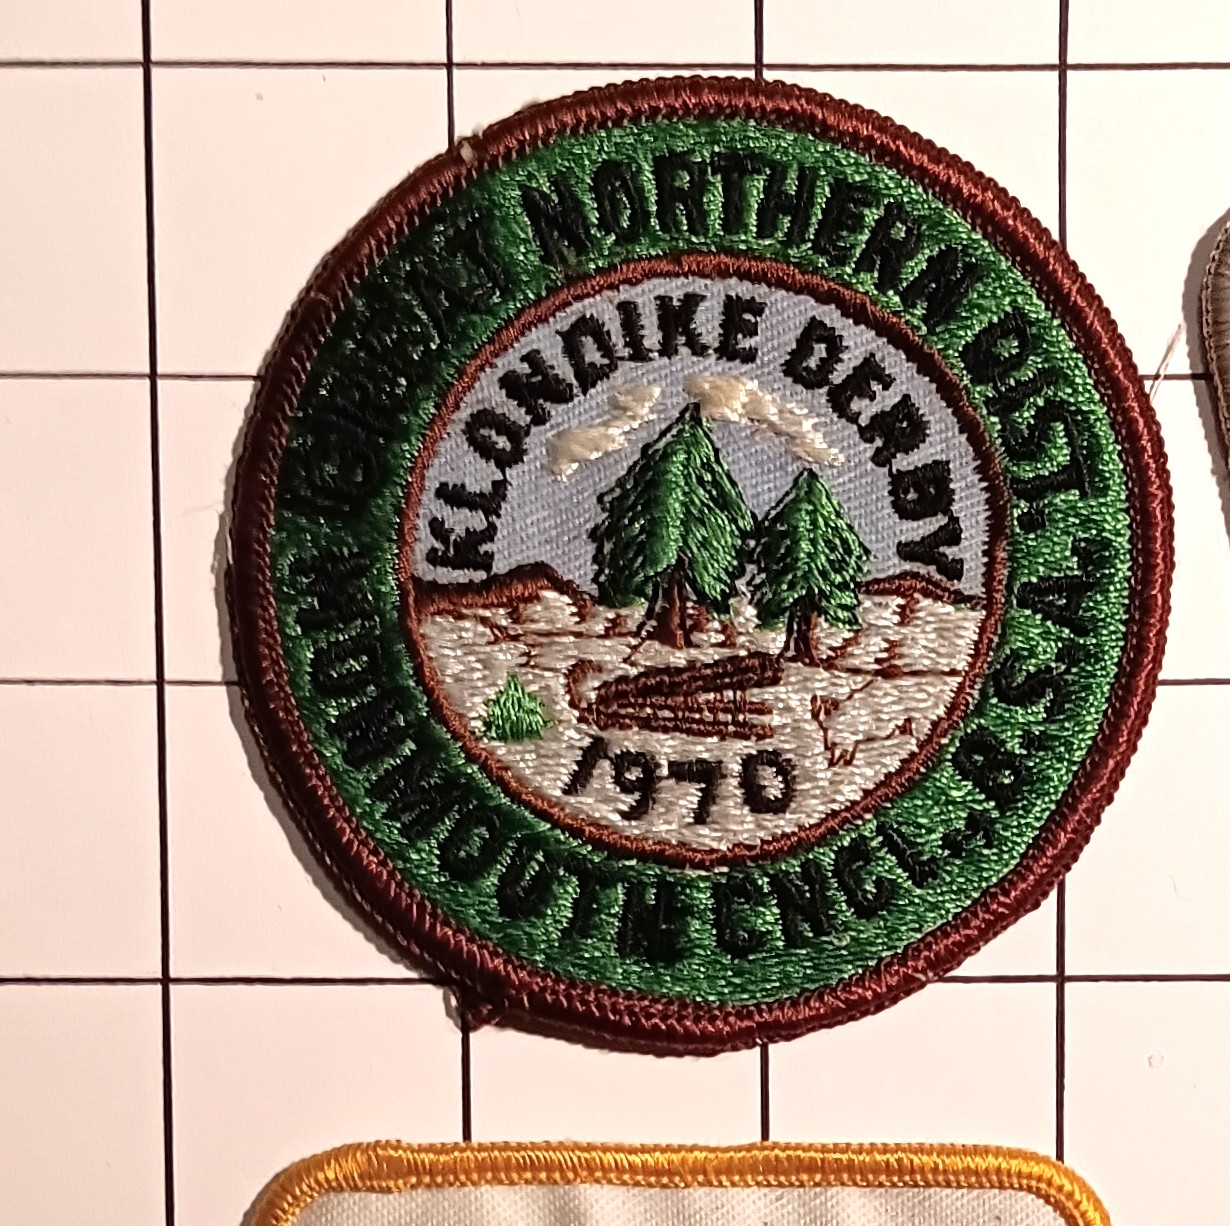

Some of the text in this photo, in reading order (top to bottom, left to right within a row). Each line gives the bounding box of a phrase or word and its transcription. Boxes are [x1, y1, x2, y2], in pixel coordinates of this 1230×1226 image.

[290, 212, 505, 518] GREAT
[522, 150, 978, 325] NORTHERN
[425, 293, 964, 582] KLONDIKE DERBY
[288, 548, 676, 963] MONMOUTH
[566, 736, 798, 824] 1970
